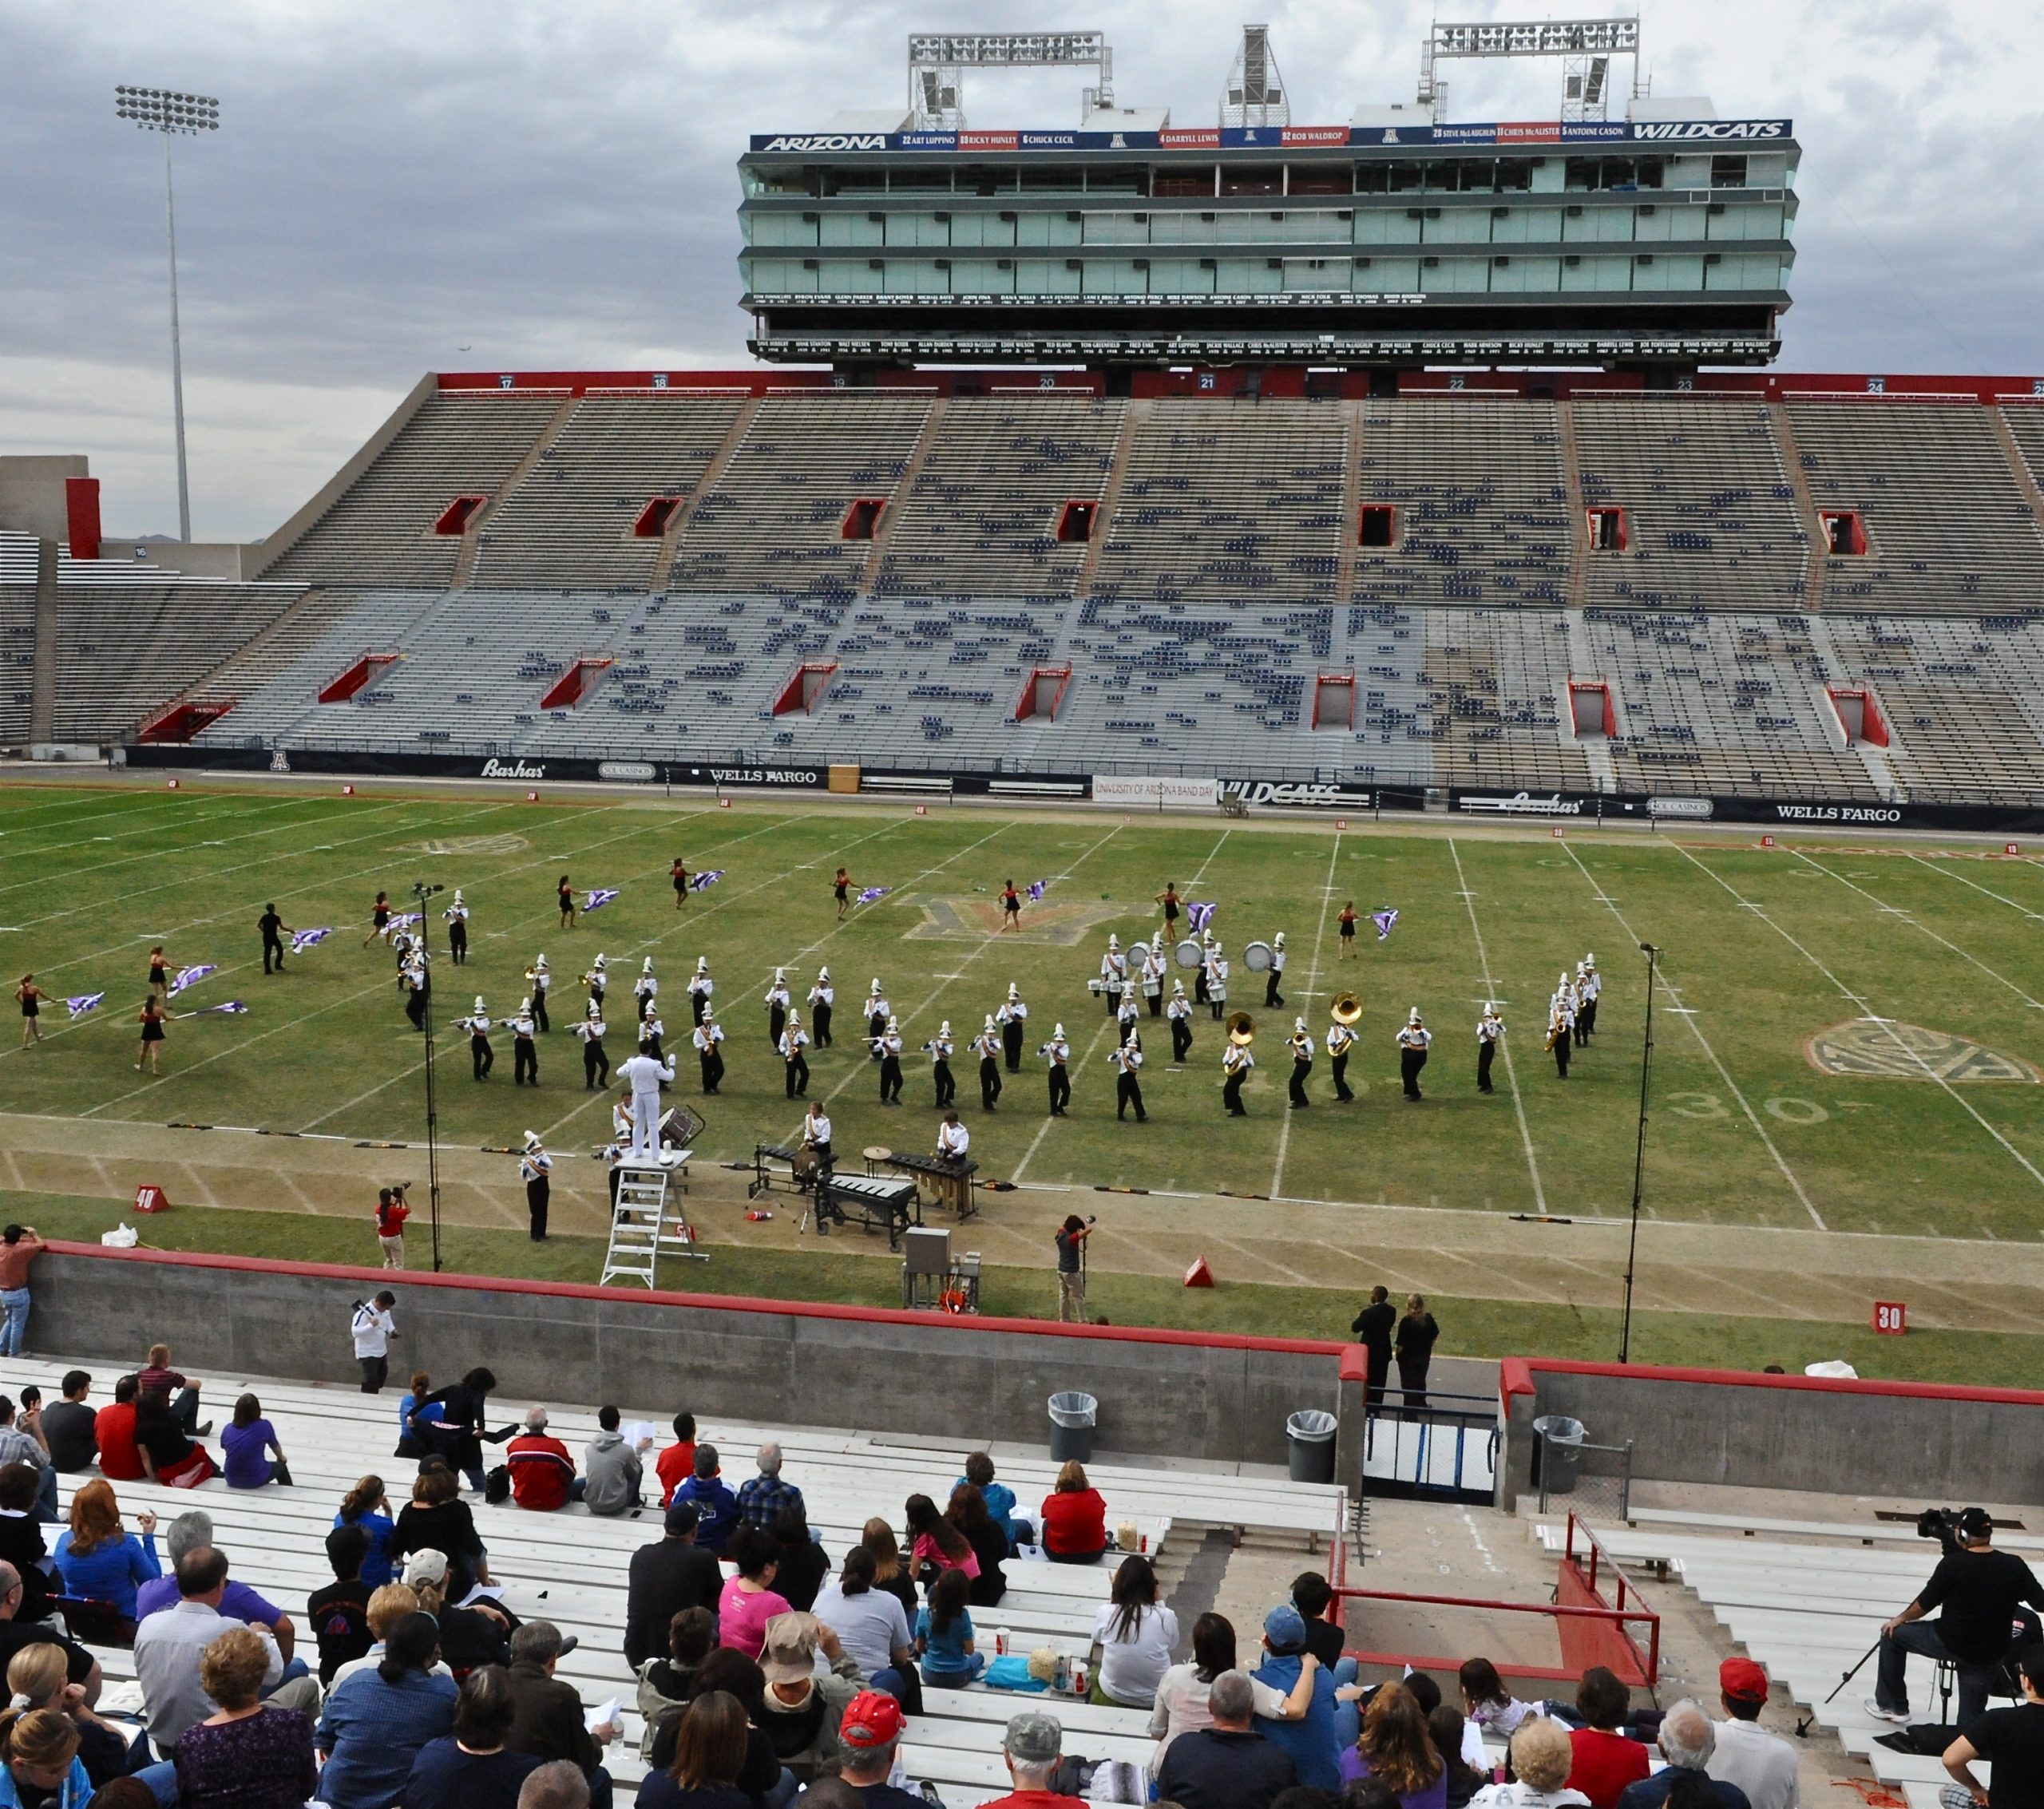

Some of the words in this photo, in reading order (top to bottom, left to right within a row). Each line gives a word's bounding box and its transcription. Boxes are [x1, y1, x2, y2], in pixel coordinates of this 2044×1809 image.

[1308, 132, 1343, 141] WALDROP
[1497, 128, 1503, 137] 11
[1525, 128, 1559, 137] McALISTER
[1634, 123, 1784, 139] WILDCATS
[763, 135, 886, 151] ARIZONA
[902, 135, 910, 144] 22
[925, 136, 955, 144] LUPPINO
[1023, 135, 1028, 144] 6
[501, 379, 512, 389] 17
[655, 378, 666, 389] 18
[834, 378, 845, 388] 19
[1040, 378, 1054, 389] 20
[1201, 378, 1213, 389] 21
[1450, 379, 1464, 390] 22
[1678, 380, 1692, 390] 23
[1868, 382, 1883, 393] 24
[136, 548, 146, 557] 16
[481, 758, 546, 778] Bashas'
[709, 770, 763, 782] WELLS
[766, 770, 817, 783] FARGO
[1134, 785, 1143, 794] OF
[1146, 785, 1176, 795] ARIZONA
[1178, 786, 1198, 796] BAND
[1199, 786, 1214, 797] DAY
[1777, 806, 1838, 819] WELLS
[1841, 807, 1900, 821] FARGO
[137, 1189, 154, 1209] 40
[1879, 1306, 1900, 1330] 30
